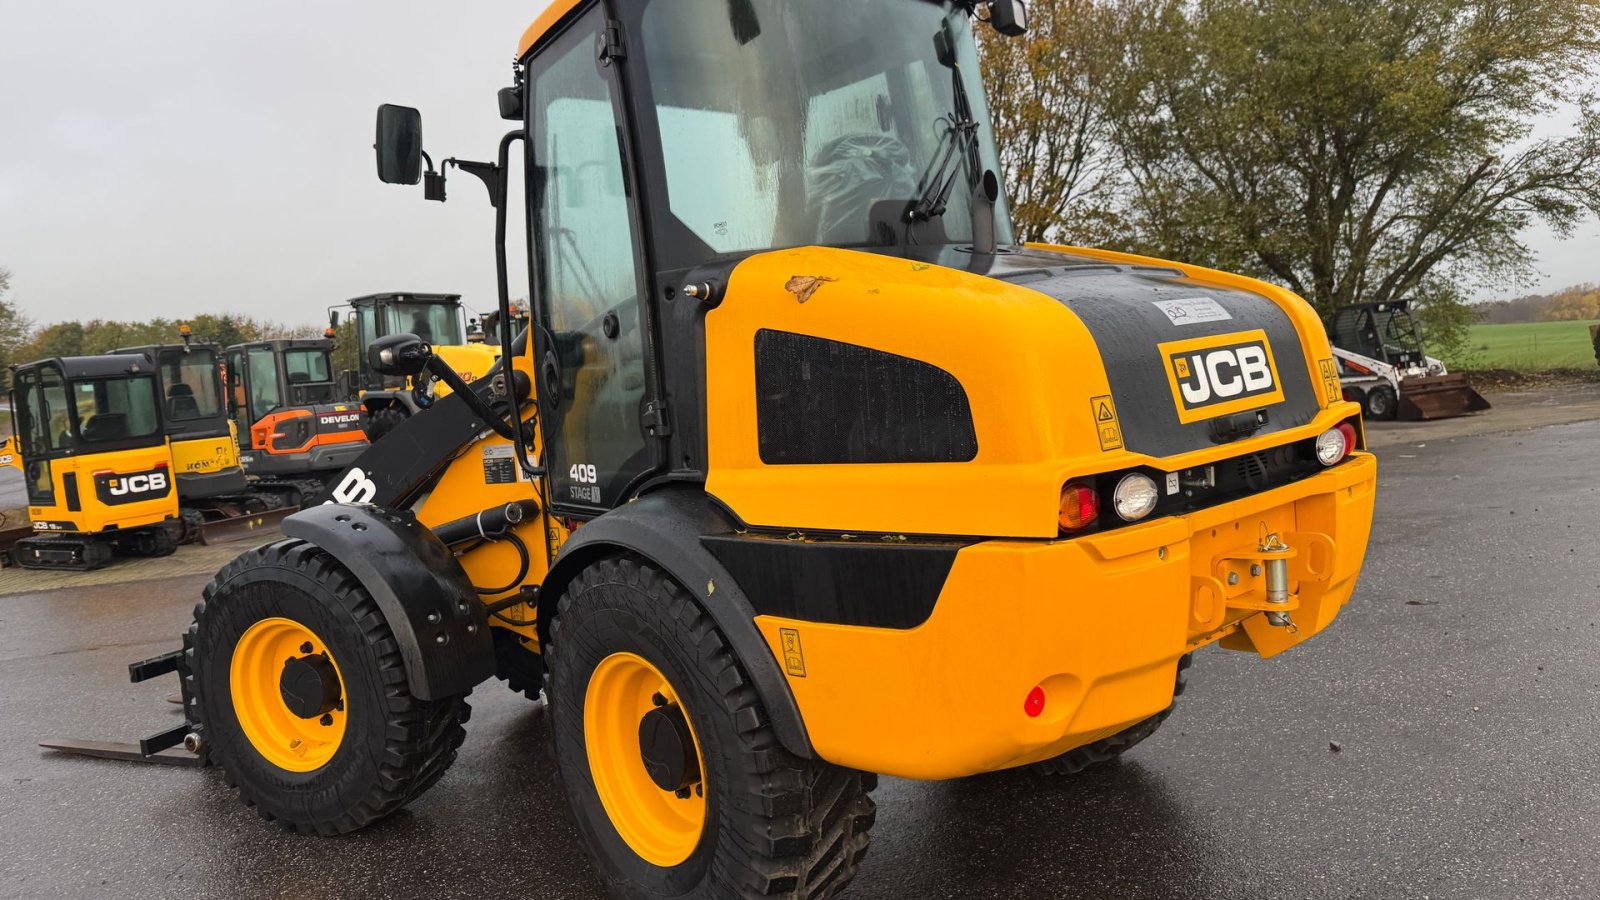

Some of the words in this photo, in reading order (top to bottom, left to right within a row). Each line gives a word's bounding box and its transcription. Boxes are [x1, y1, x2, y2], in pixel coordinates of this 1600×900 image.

[1181, 346, 1272, 403] JCB
[320, 414, 360, 424] DEVELON
[570, 463, 597, 484] 409
[110, 473, 167, 496] JCB
[570, 486, 591, 500] STAGE
[33, 521, 48, 530] JCB
